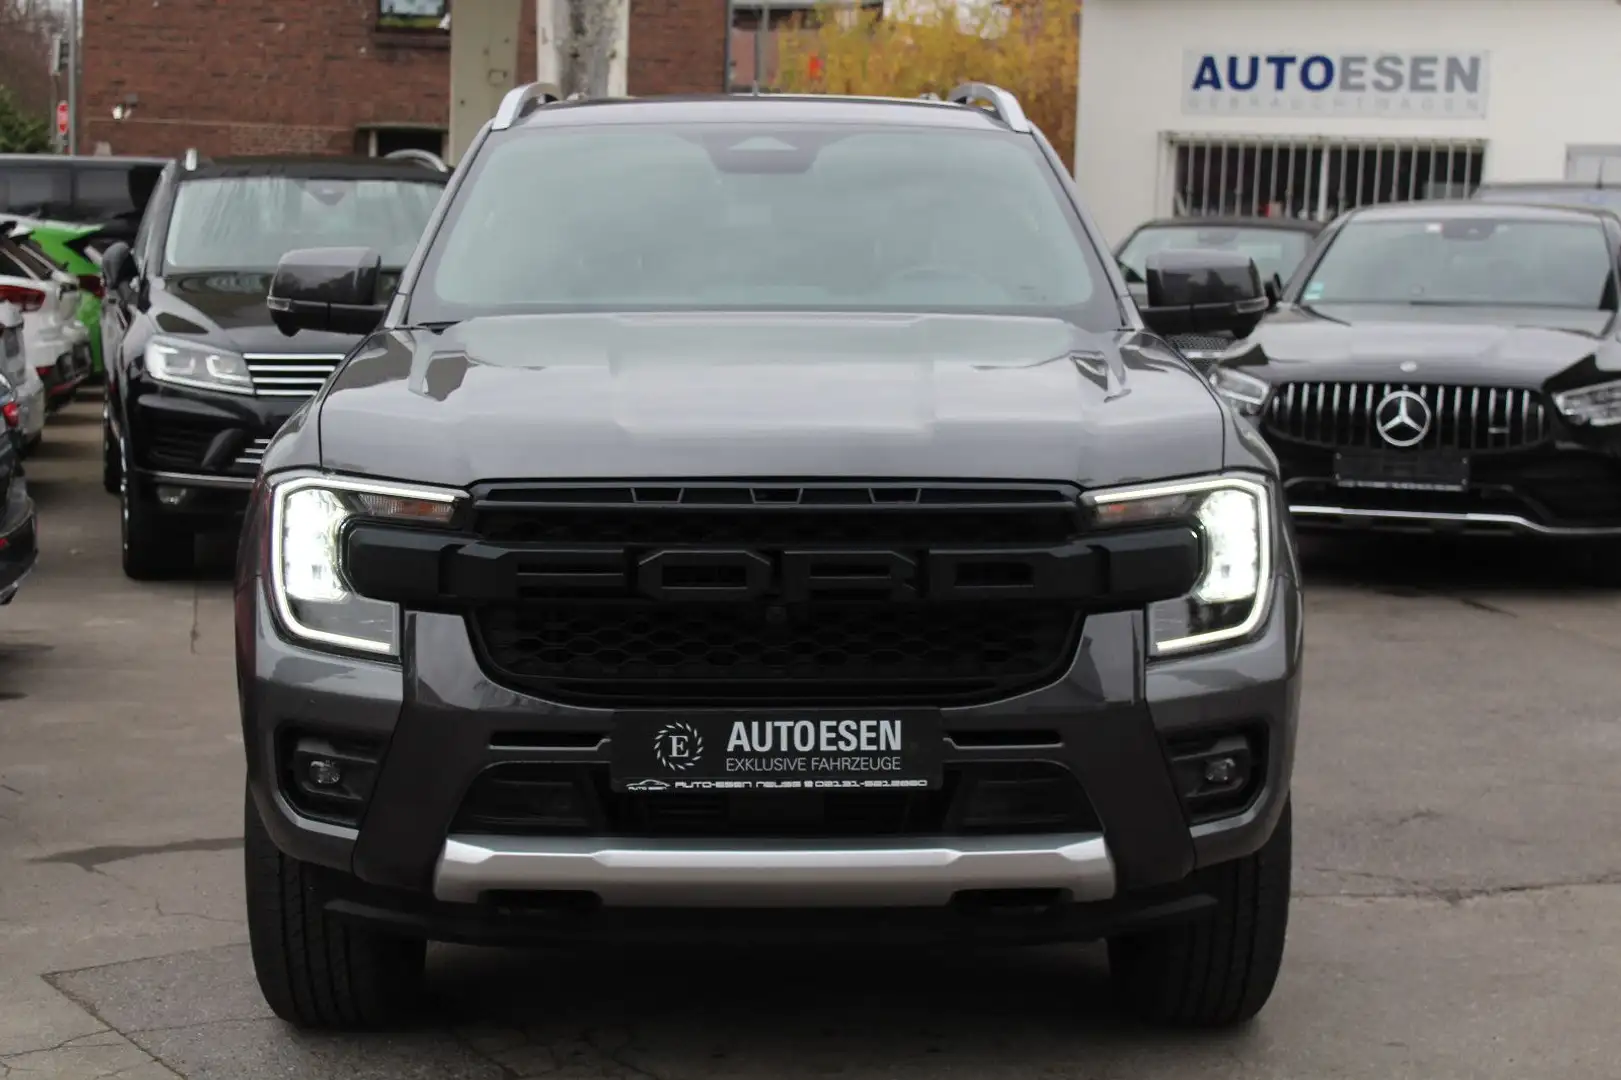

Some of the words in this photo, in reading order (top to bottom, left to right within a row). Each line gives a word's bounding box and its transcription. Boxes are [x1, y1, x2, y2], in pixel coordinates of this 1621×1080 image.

[1191, 55, 1480, 93] AUTOESEN
[461, 543, 1086, 602] FORD
[727, 720, 902, 752] AUTOESEN
[726, 757, 807, 772] EXKLUSIVE
[811, 756, 902, 771] FAHRZEUGE
